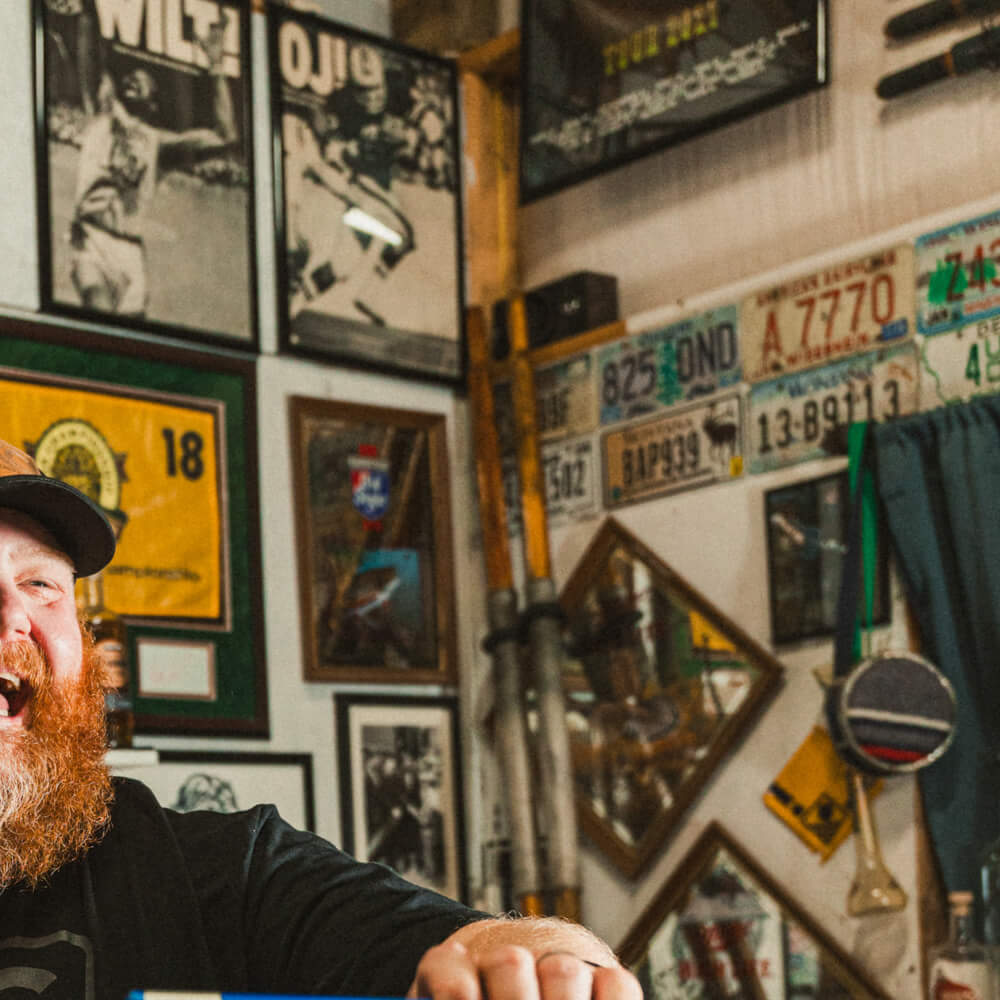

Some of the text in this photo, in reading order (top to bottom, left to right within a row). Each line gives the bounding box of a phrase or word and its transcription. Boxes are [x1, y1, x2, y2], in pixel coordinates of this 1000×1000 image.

[796, 273, 896, 346] 7770
[602, 349, 657, 406] 825
[162, 427, 205, 481] 18
